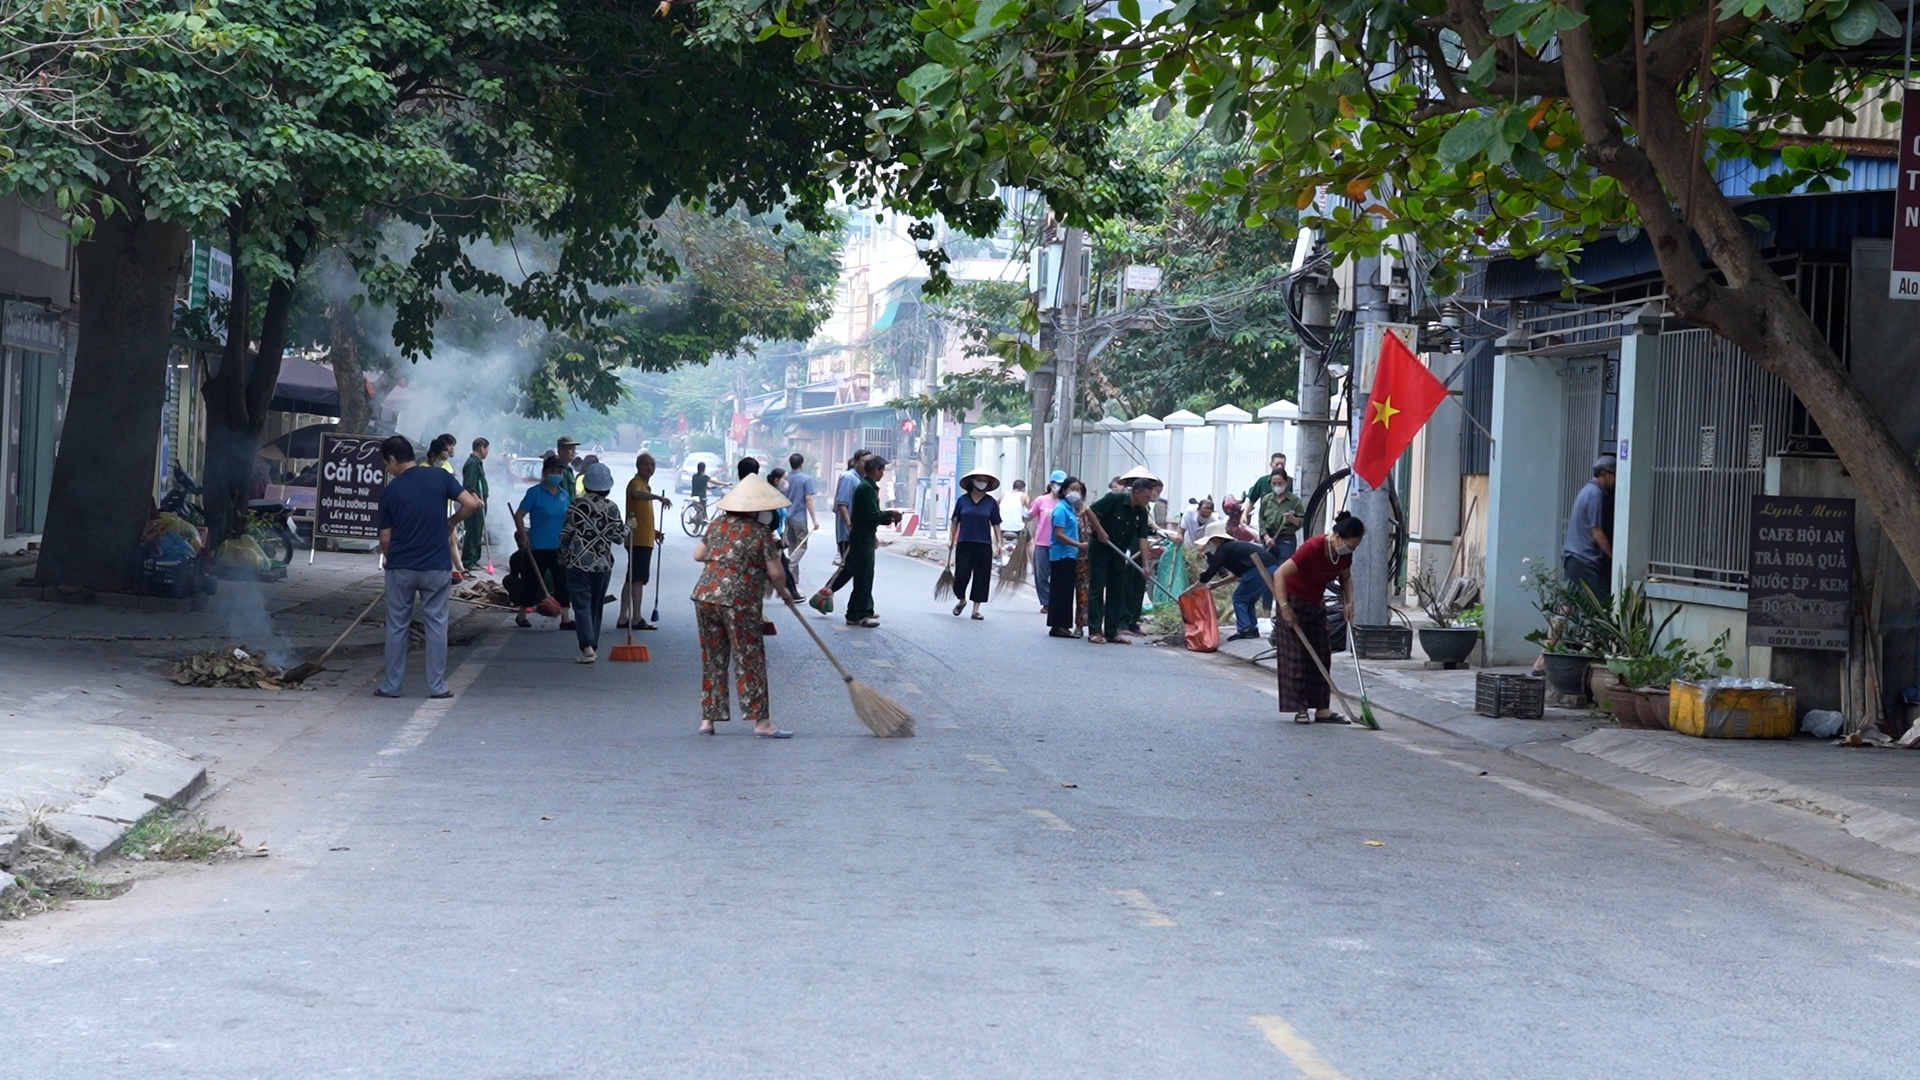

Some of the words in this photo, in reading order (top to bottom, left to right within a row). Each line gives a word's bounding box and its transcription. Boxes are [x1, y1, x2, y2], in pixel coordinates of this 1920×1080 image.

[1898, 277, 1919, 295] Alo
[323, 457, 352, 482] Cắt
[356, 463, 383, 484] Tóc
[334, 485, 353, 495] Nam
[358, 486, 370, 496] Nữ
[329, 509, 343, 520] LẤY
[1759, 527, 1794, 542] CAFE
[1796, 525, 1821, 546] HỘI
[1824, 530, 1845, 543] AN
[1754, 548, 1782, 565] TRÀ
[1785, 552, 1814, 567] HOA
[1817, 549, 1847, 570] QUẢ
[1751, 572, 1789, 590] NƯỚC
[1792, 573, 1809, 590] ÉP
[1819, 578, 1849, 592] KEM
[1767, 636, 1849, 648] 0978.861.626
